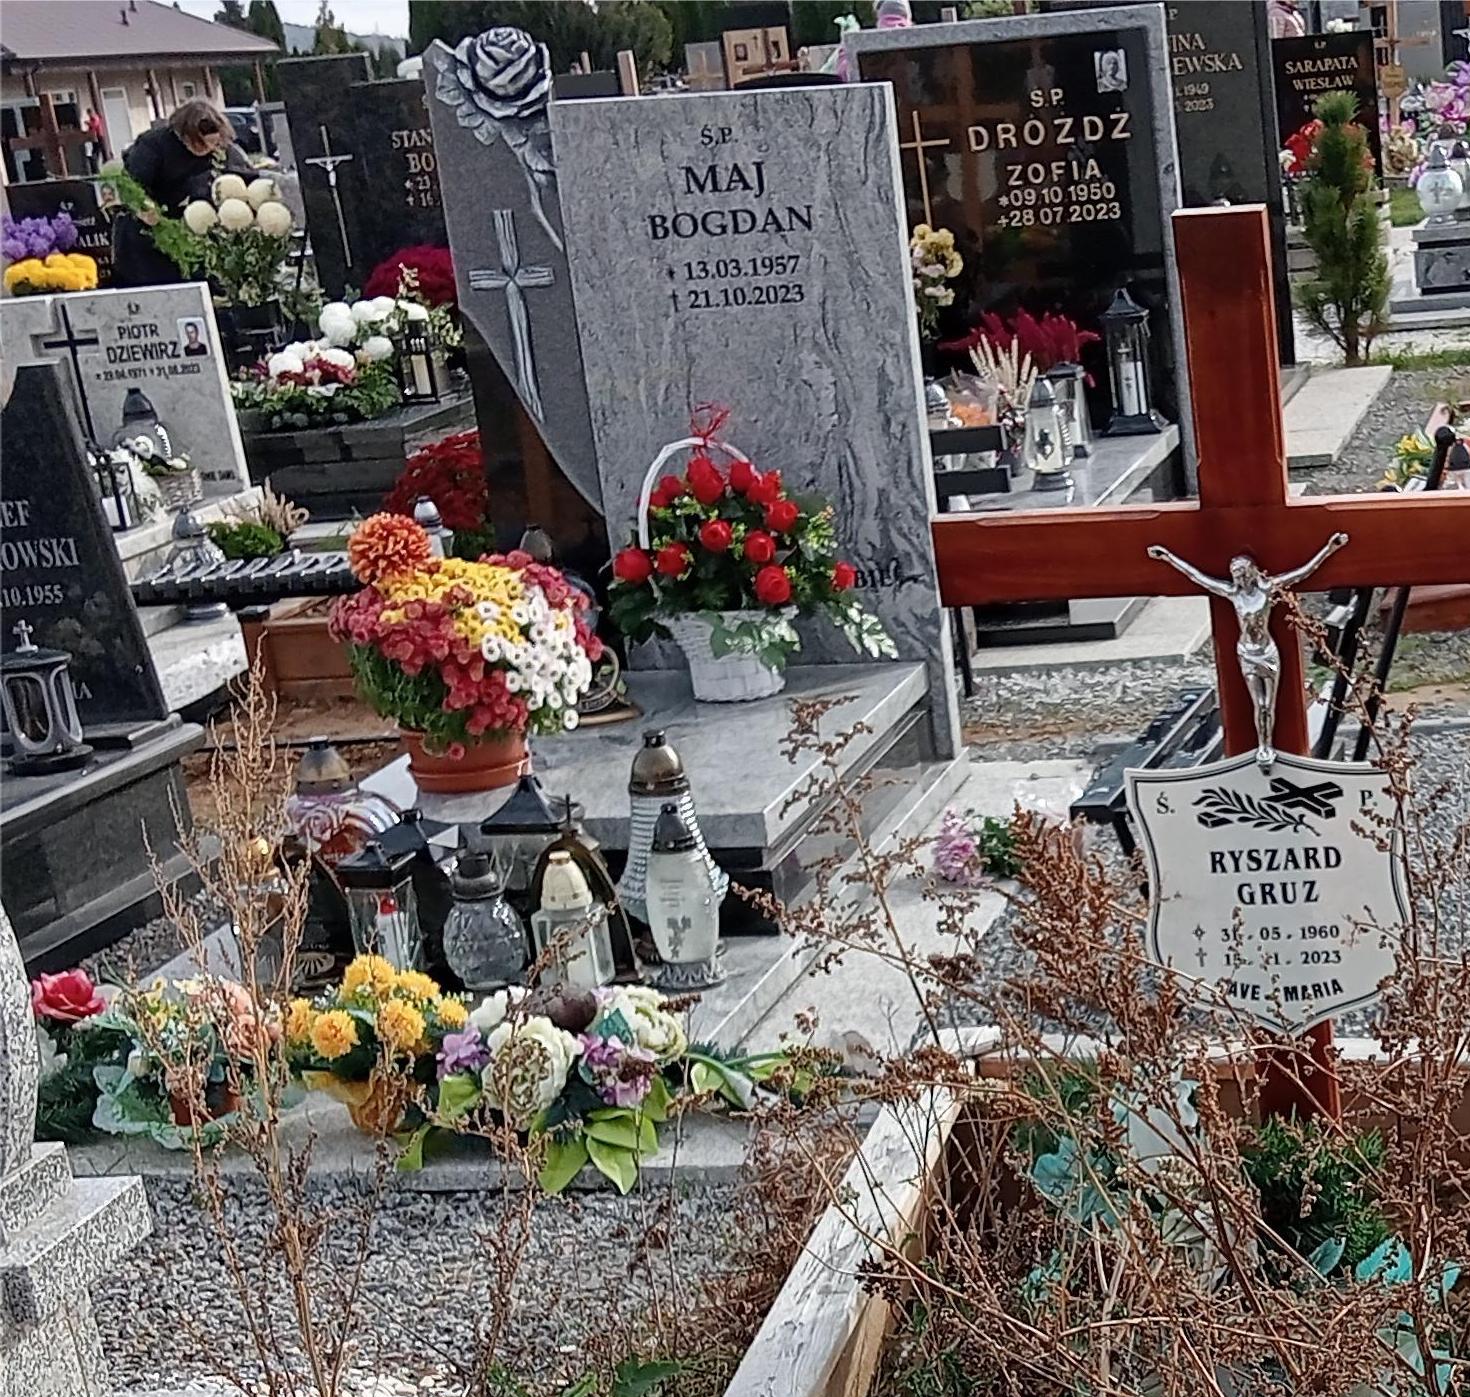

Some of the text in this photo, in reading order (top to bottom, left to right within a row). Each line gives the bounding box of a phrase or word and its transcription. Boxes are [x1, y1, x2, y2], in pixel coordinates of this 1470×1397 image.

[1172, 53, 1243, 76] EWSKA
[1285, 56, 1358, 75] SARAPATA
[678, 162, 766, 198] MAJ
[1006, 158, 1102, 186] ZOFIA
[647, 205, 813, 240] BOGDAN
[117, 323, 160, 340] PIOTR
[106, 341, 181, 365] DZIEWIRZ
[0, 537, 80, 570] OWSKI
[1209, 846, 1343, 874] RYSZARD
[1236, 880, 1321, 905] GRUZ
[1228, 978, 1344, 1002] AVE MARIA
